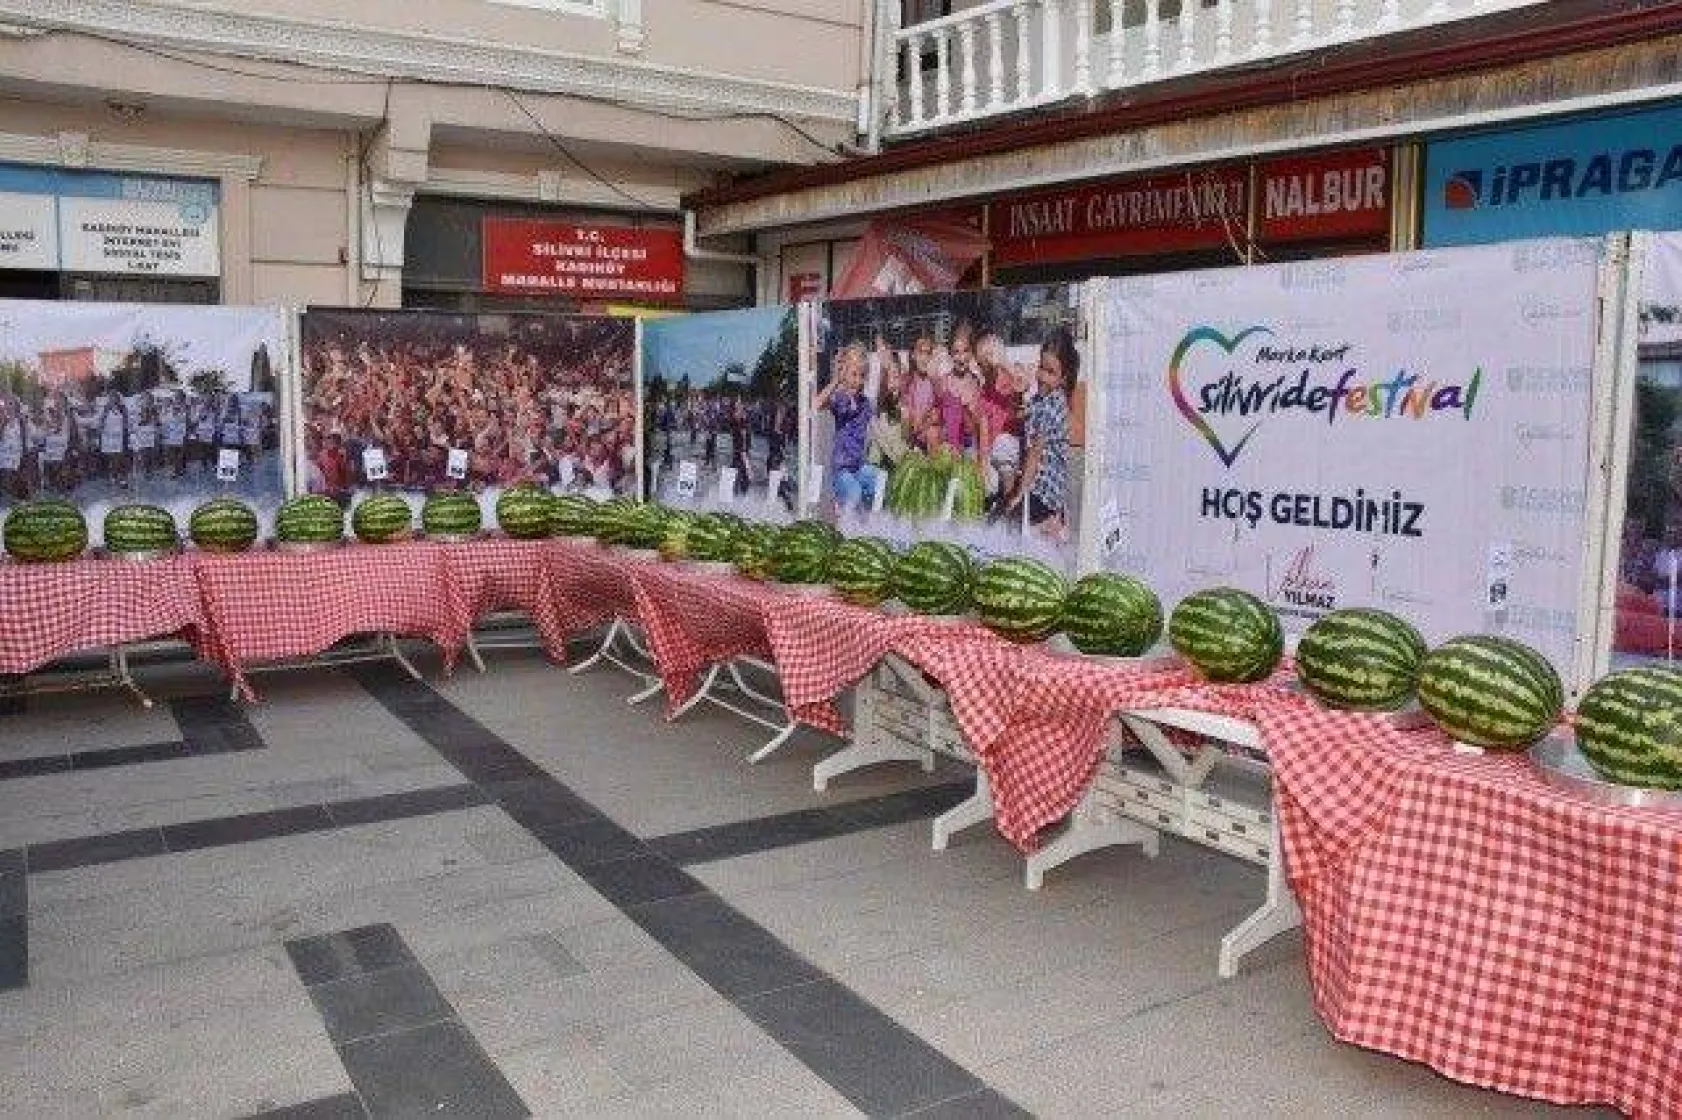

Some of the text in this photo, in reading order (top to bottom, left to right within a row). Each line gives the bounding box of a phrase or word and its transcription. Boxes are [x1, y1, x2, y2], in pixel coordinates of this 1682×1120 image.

[1265, 166, 1386, 218] NALBUR
[576, 227, 606, 242] T.C.
[556, 259, 627, 275] KADIKÖY
[500, 274, 576, 289] MAHALLE
[1200, 488, 1425, 537] HOŞ GELDİNİZ
[1284, 590, 1335, 609] YILMAZ
